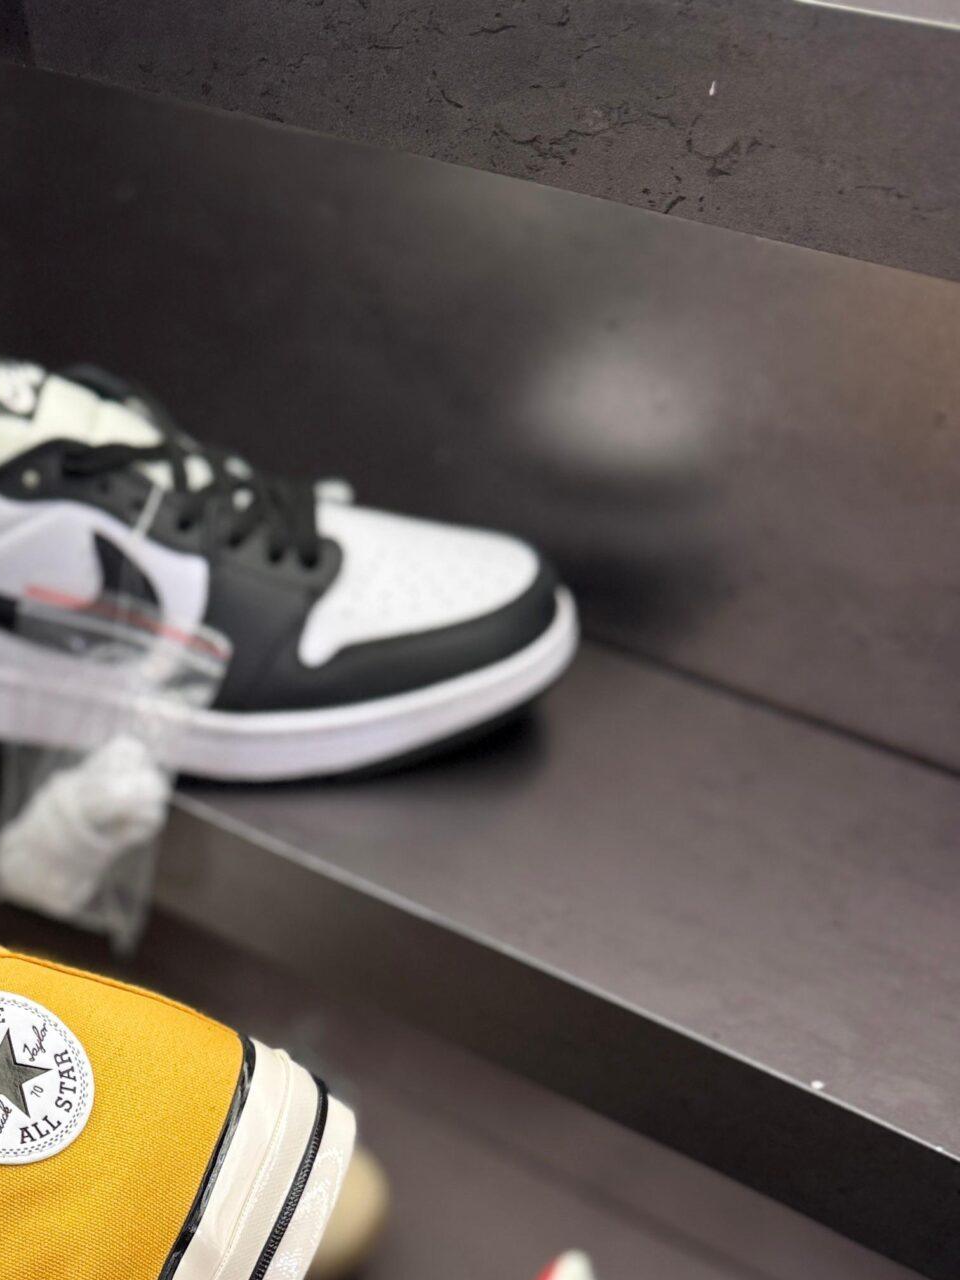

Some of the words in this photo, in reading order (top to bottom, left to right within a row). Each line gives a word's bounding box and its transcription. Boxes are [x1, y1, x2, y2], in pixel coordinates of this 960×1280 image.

[23, 1022, 49, 1062] Taylor
[19, 1115, 62, 1145] ALL
[54, 1049, 78, 1113] STAR
